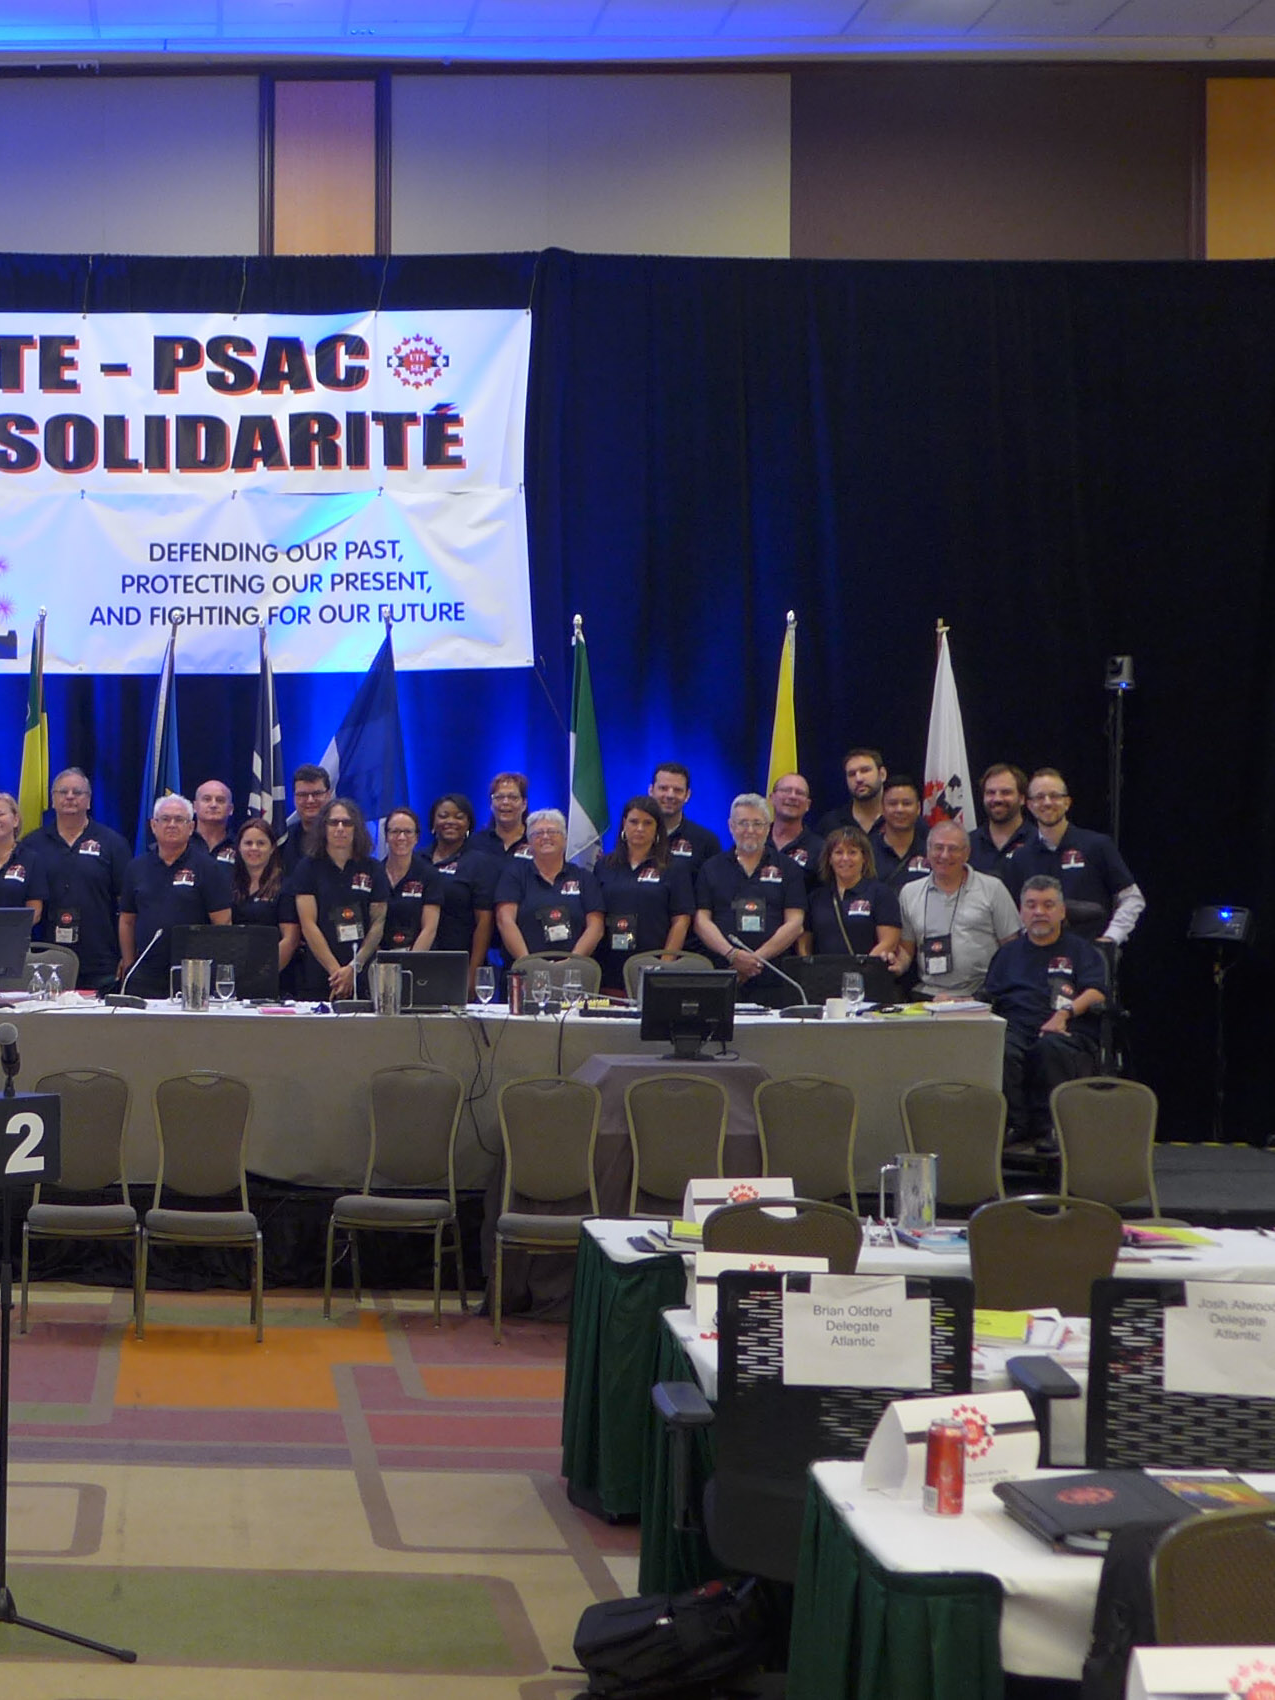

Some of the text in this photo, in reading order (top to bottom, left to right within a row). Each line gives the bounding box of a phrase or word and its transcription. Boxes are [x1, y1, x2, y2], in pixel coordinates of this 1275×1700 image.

[100, 362, 133, 377] -
[153, 333, 370, 393] PSAC
[148, 540, 405, 563] DEFENDING OUR PAST,
[121, 571, 433, 594] PROTECTING OUR PRESENT,
[89, 602, 466, 626] AND FIGHTING FOR OUR FUTURE
[4, 1111, 45, 1175] 2
[813, 1304, 893, 1317] Brian Oldford
[1197, 1298, 1228, 1310] Josh
[826, 1320, 880, 1334] Delegate
[1209, 1312, 1267, 1328] Delegate
[830, 1335, 876, 1347] Atlantic
[1214, 1328, 1262, 1342] Atlantic
